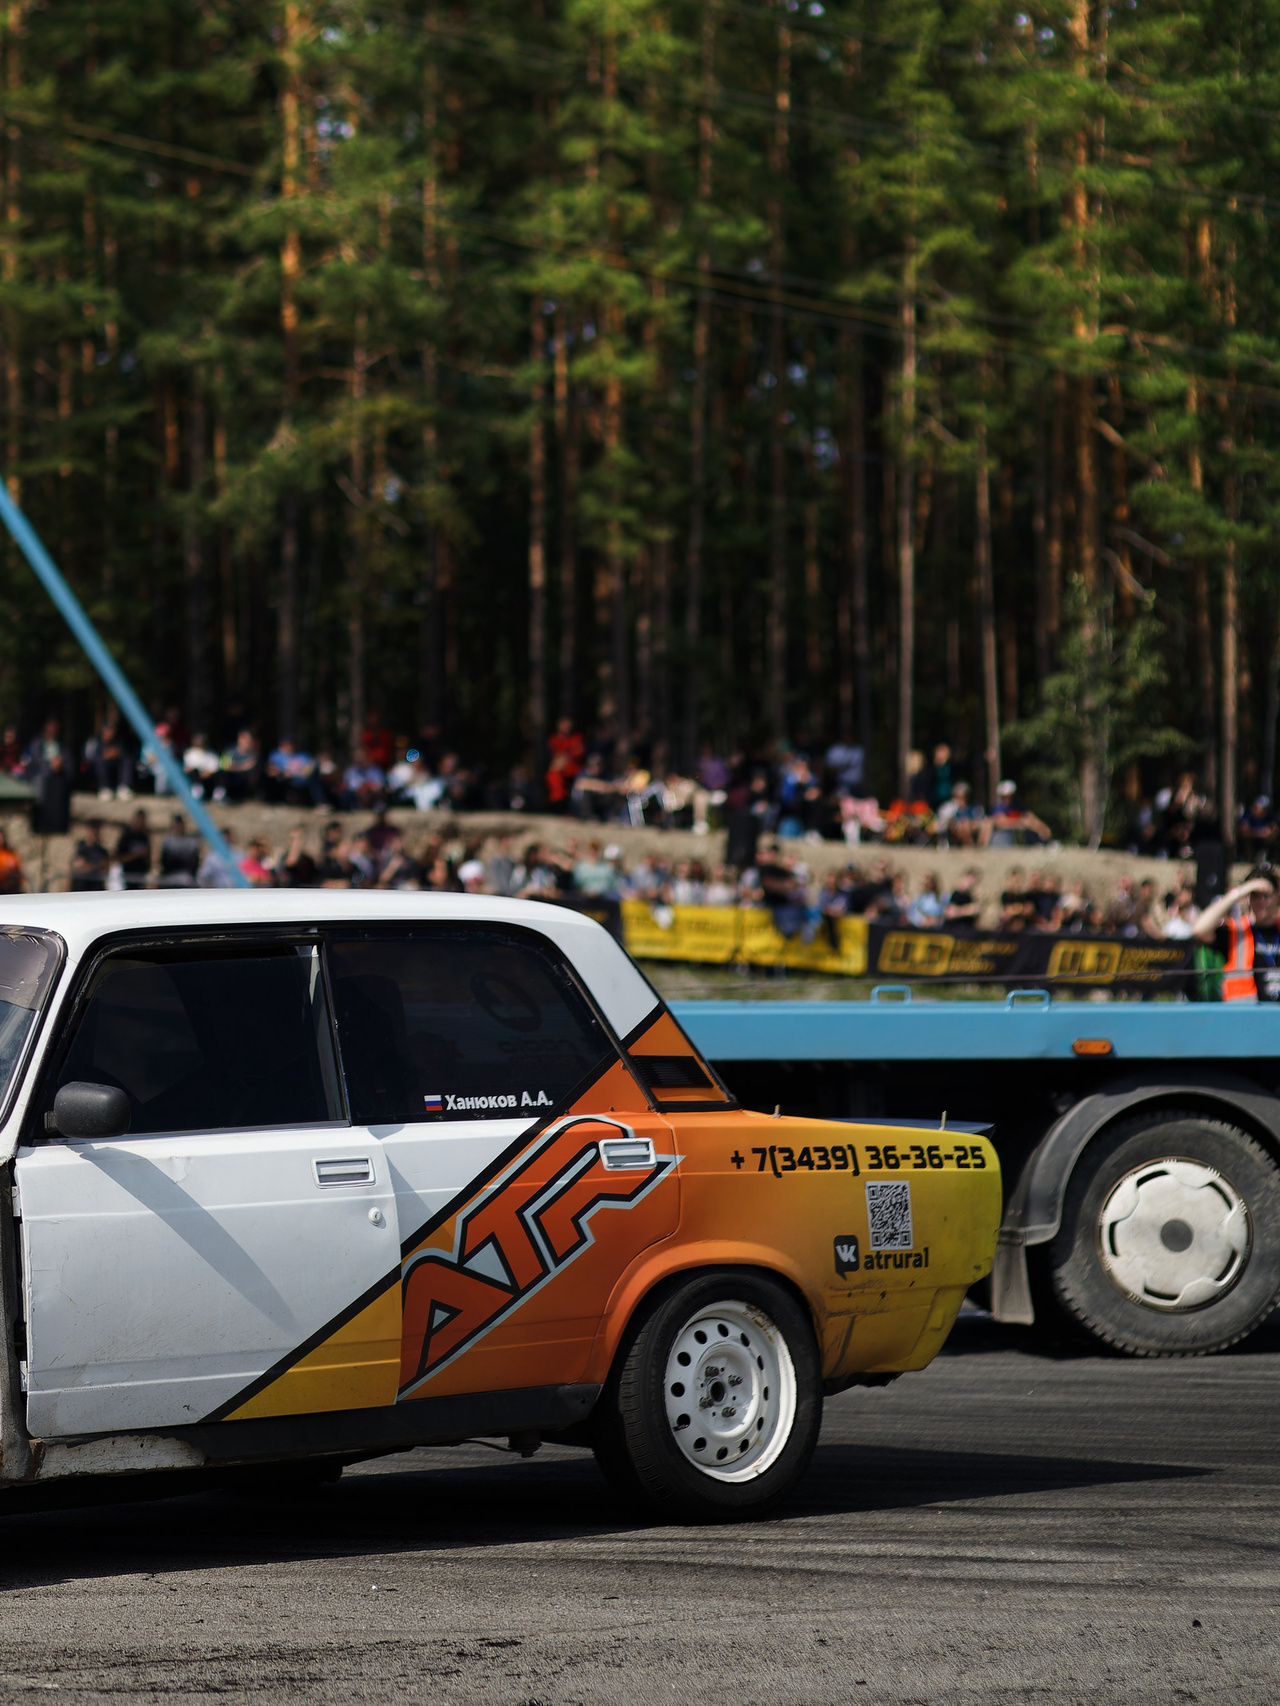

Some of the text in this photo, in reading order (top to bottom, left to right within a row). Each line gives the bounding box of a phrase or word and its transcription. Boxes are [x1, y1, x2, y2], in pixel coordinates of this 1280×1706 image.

[444, 1094, 517, 1111] Ханюков
[865, 1145, 986, 1170] 36-36-25
[864, 1247, 930, 1270] atrural
